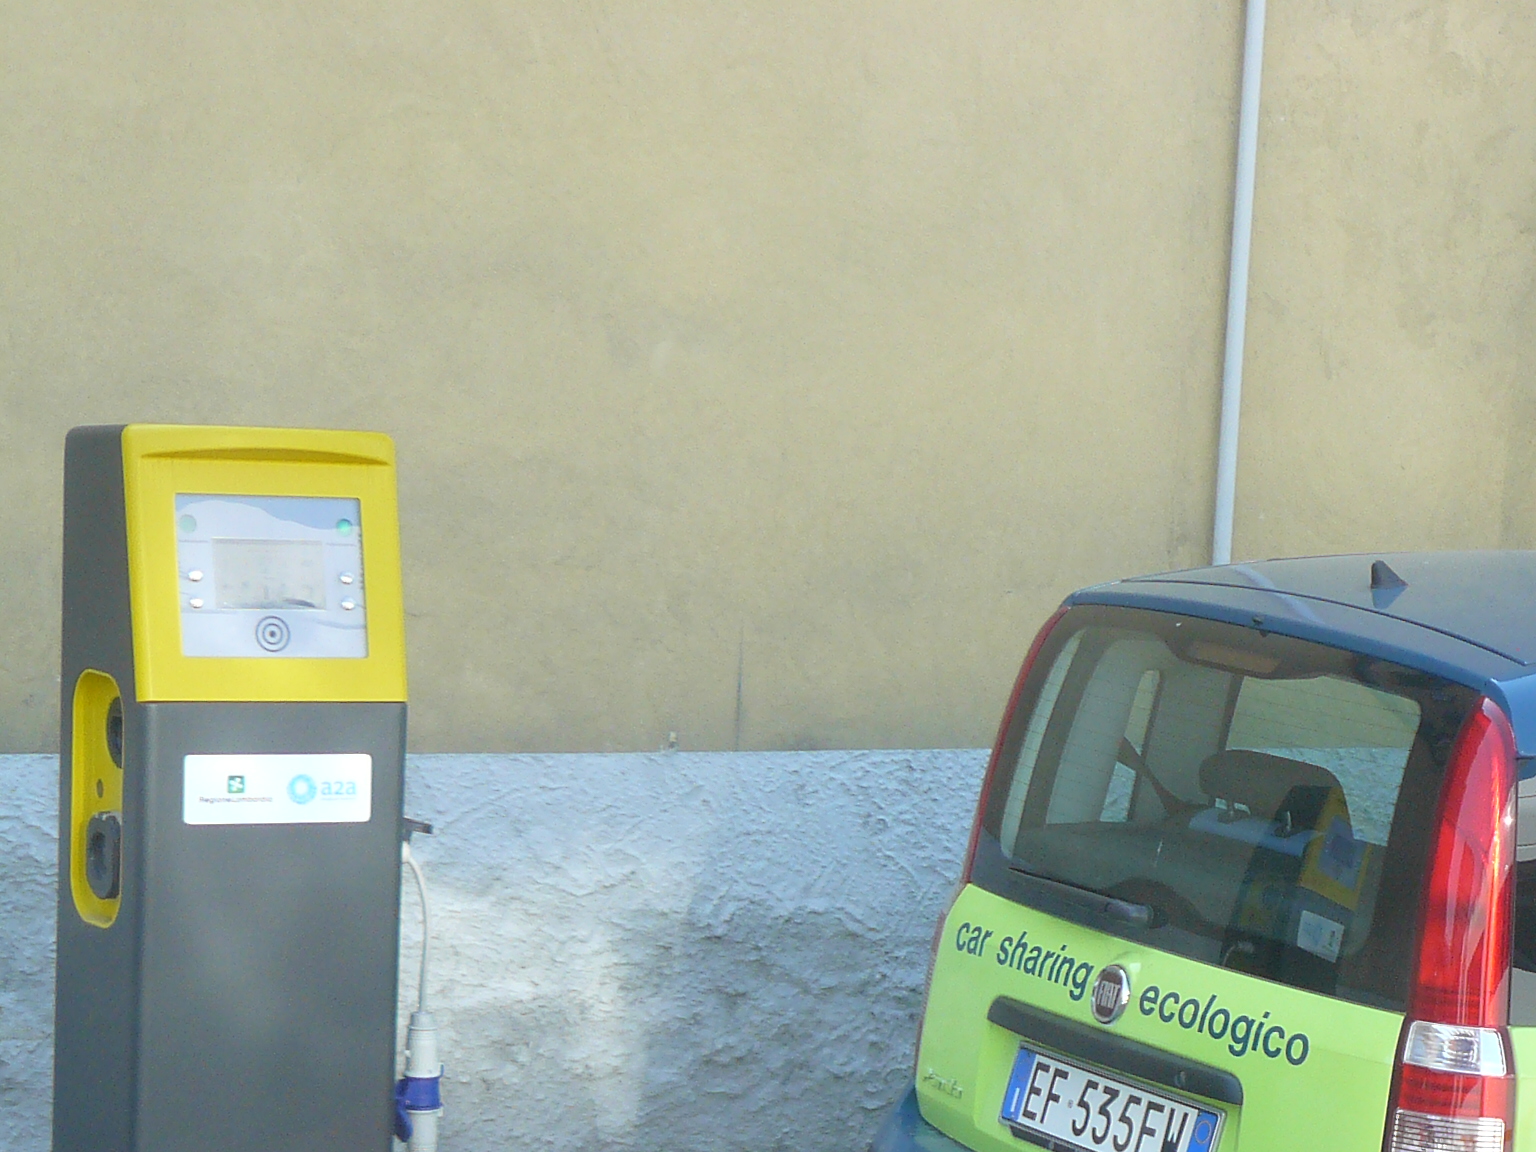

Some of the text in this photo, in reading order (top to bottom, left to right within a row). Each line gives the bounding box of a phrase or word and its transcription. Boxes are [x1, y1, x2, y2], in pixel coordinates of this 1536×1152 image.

[321, 781, 357, 796] a2a
[956, 921, 1310, 1065] car sharing ecologico
[1097, 980, 1121, 1009] FIAT
[1022, 1061, 1069, 1124] EF
